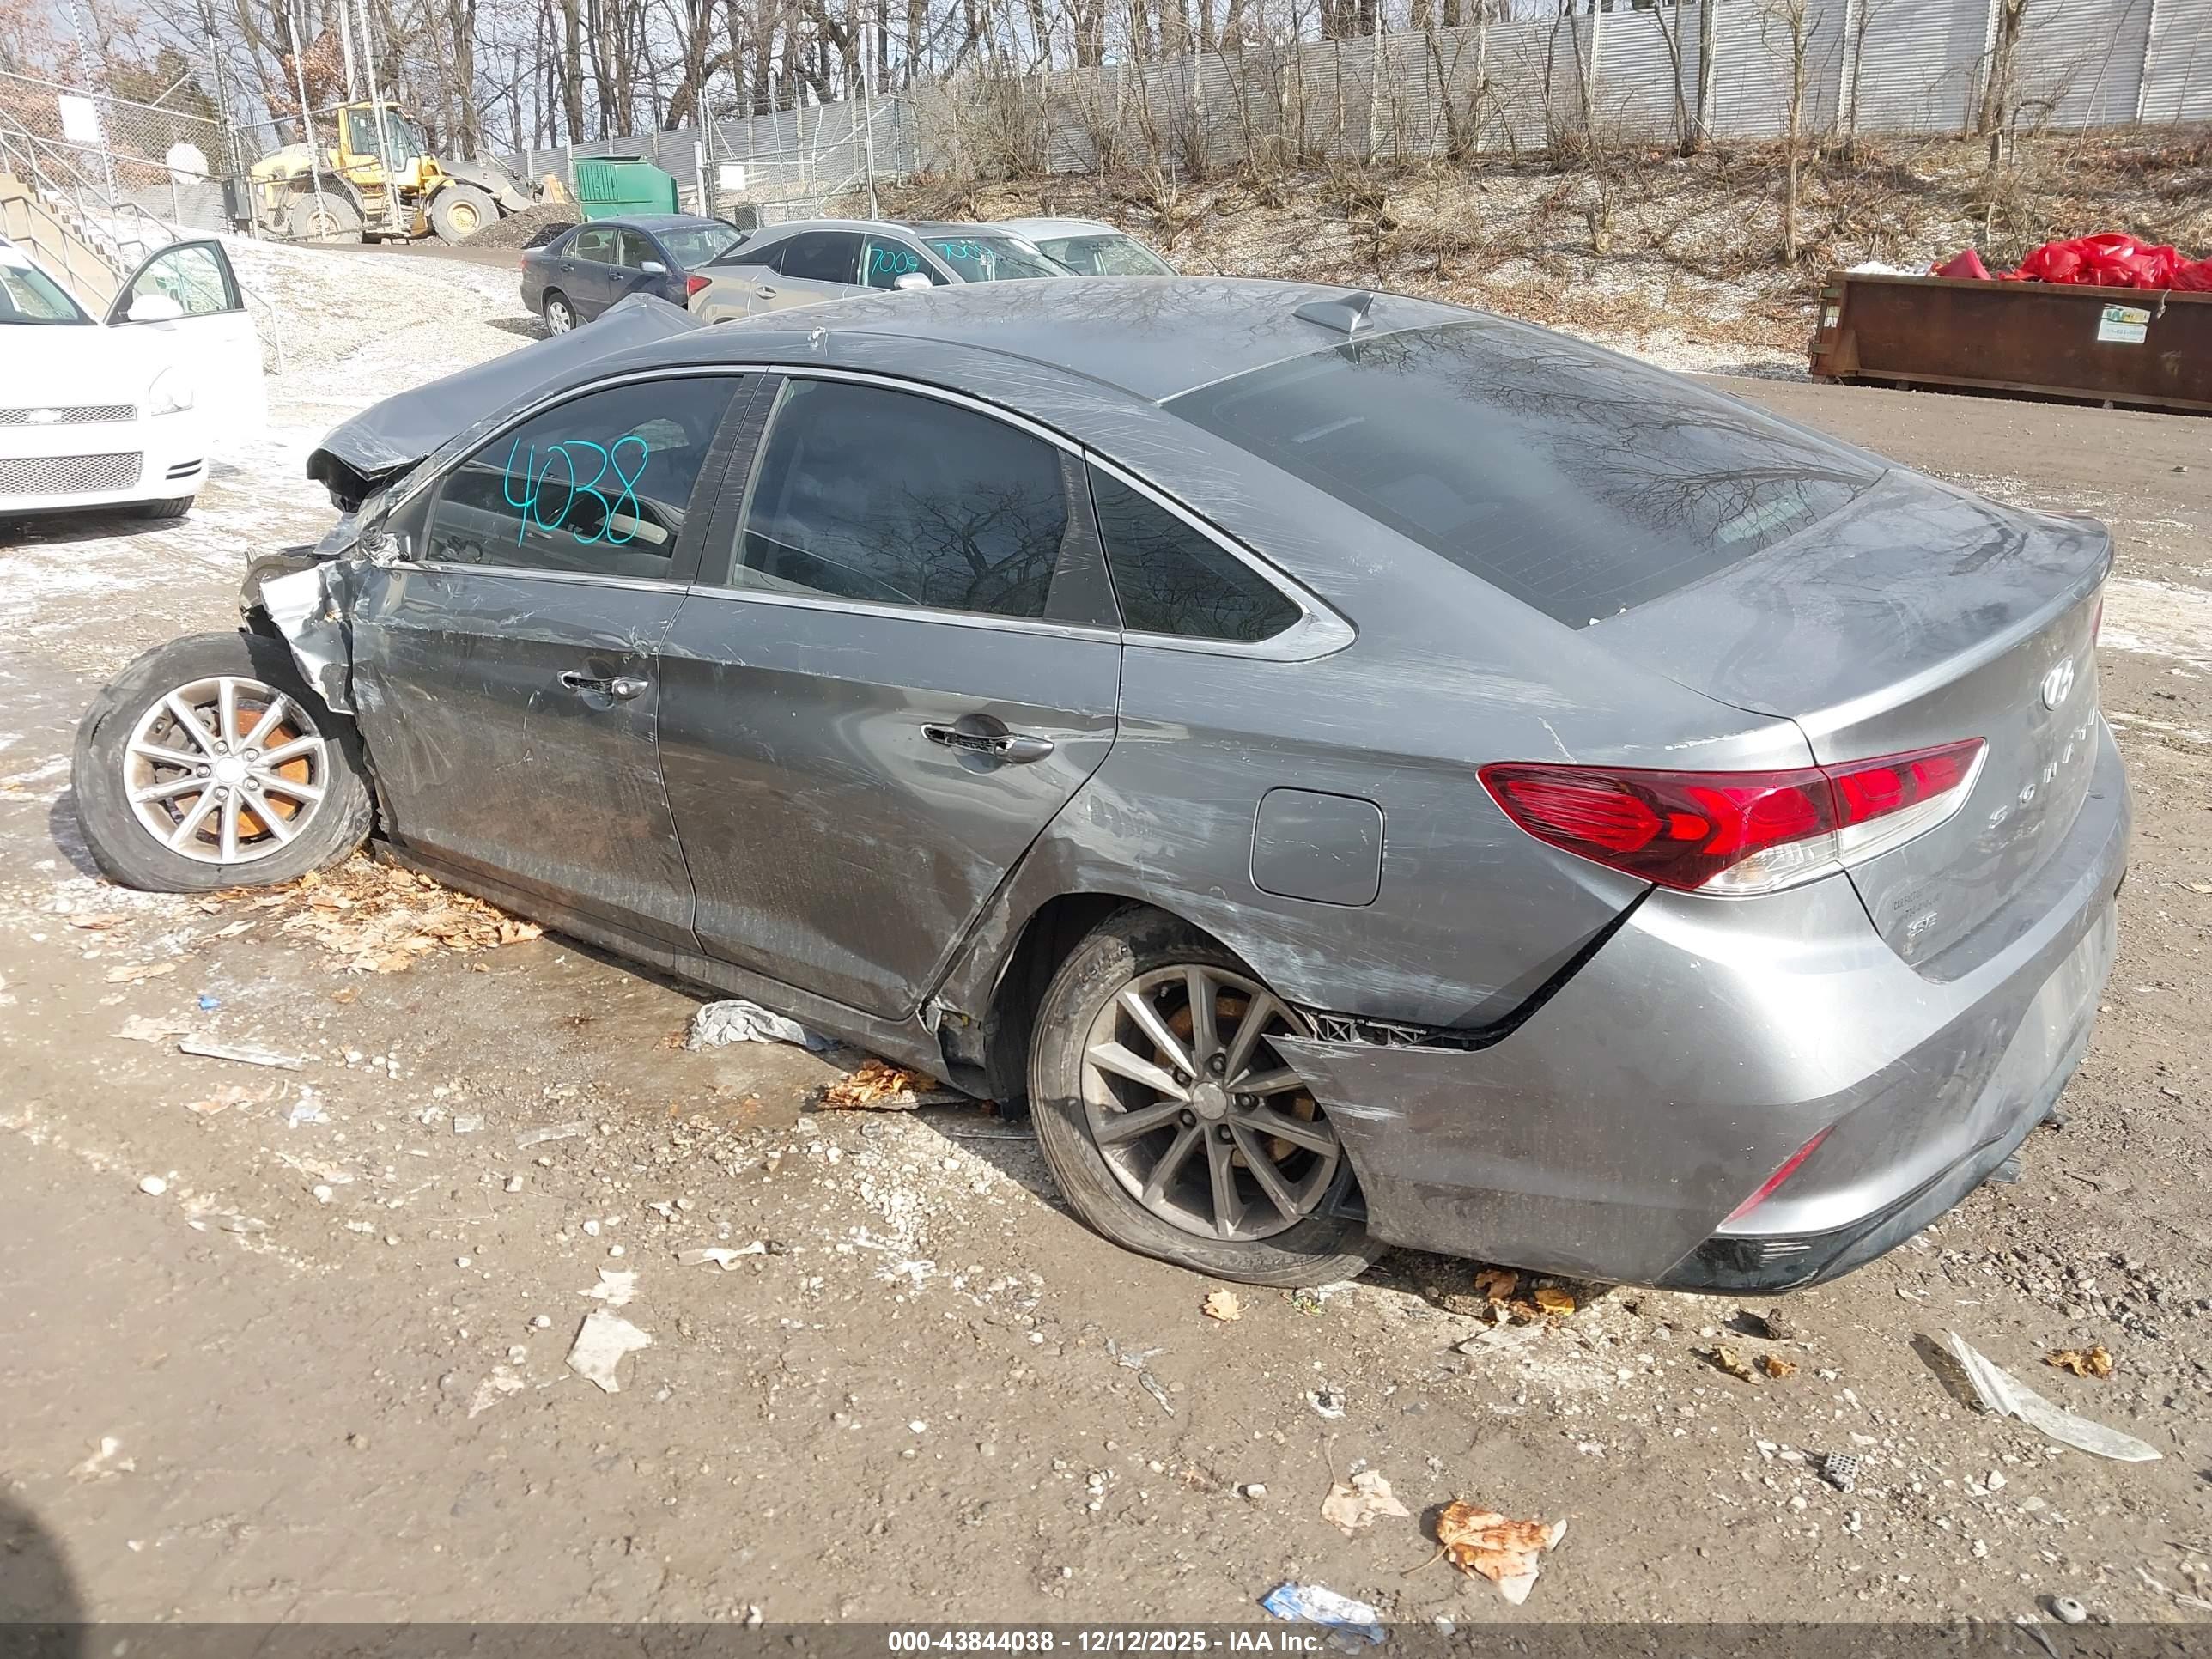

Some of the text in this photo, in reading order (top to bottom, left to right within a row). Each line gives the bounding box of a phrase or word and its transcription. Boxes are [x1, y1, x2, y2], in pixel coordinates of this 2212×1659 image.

[871, 248, 919, 276] 7009
[934, 244, 995, 268] 7009
[504, 435, 648, 548] 4038
[1906, 911, 1938, 938] SE
